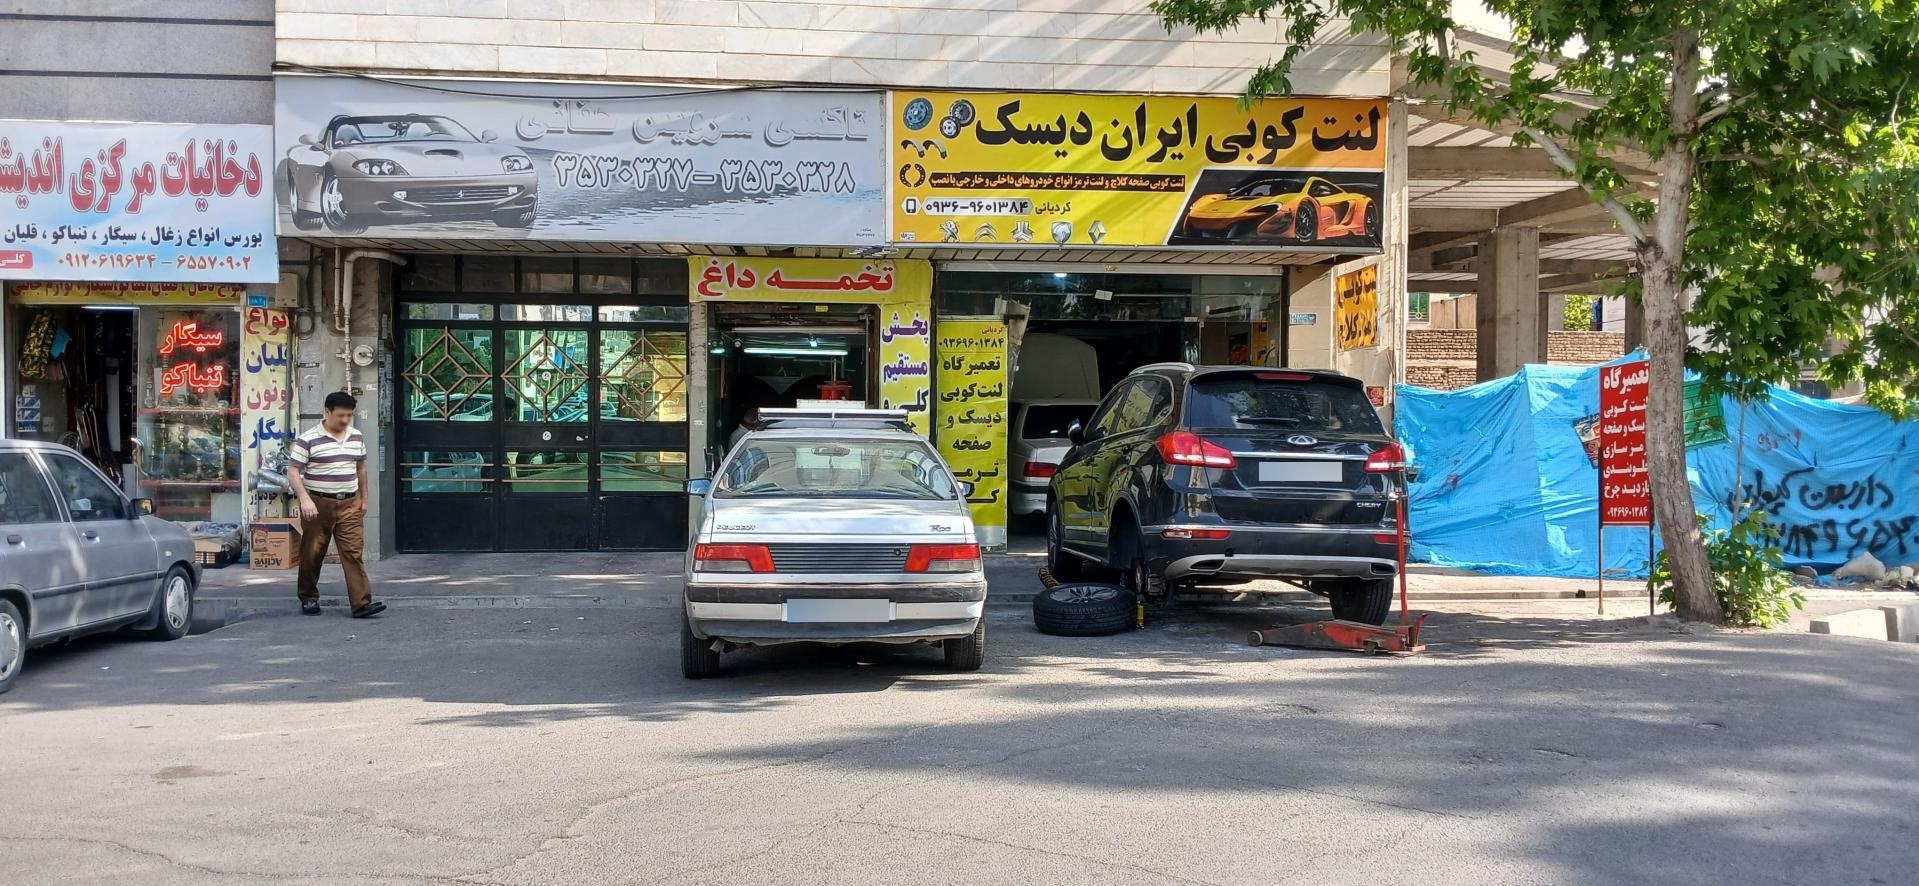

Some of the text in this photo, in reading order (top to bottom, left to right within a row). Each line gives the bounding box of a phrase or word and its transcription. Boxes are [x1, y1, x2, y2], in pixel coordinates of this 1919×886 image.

[975, 101, 1381, 165] لنت کوبی ایران دیسک
[0, 136, 262, 214] دخانیات مرکزی اندیش
[956, 174, 984, 187] خارجی
[984, 178, 990, 187] و
[989, 174, 1014, 187] داخلی
[1014, 175, 1054, 188] خودروهای
[1054, 175, 1073, 188] انواع
[1073, 176, 1090, 188] ترمز
[1090, 175, 1104, 186] لنت
[1110, 175, 1128, 189] کلاچ
[1128, 176, 1150, 186] صفحه
[1170, 177, 1184, 187] لنت
[1105, 179, 1109, 189] و
[1150, 178, 1169, 190] کوبی
[1035, 201, 1071, 214] کردیانی
[4, 223, 38, 244] قلیان
[51, 224, 88, 245] تنباکو
[100, 225, 137, 246] سیگار
[150, 226, 183, 246] زغال
[187, 227, 220, 247] انواع
[224, 231, 263, 248] بورس
[58, 252, 156, 269] ۰۹۱۲۰۶۱۹۶۳۴
[176, 255, 251, 270] ۶۵۵۷۰۹۰۲
[697, 260, 893, 297] تخمه داغ
[882, 312, 928, 344] پخش
[160, 322, 222, 354] سیگار
[939, 337, 1004, 349] ۰۹۳۶۹۶۰۱۳۸۴
[884, 353, 928, 384] مستقیم
[160, 363, 223, 394] تنباکو
[1603, 362, 1650, 394] تعمیرگاه
[941, 381, 1003, 402] لنت کوبی
[1603, 399, 1628, 419] کوبی
[946, 409, 1002, 429] دیسک و
[1603, 419, 1646, 437] یسک و صفحه
[952, 435, 992, 451] صفحه
[1604, 482, 1621, 499] چرخ
[1607, 505, 1648, 518] ۰۹۳۶۹۶۰۱۳۸۴
